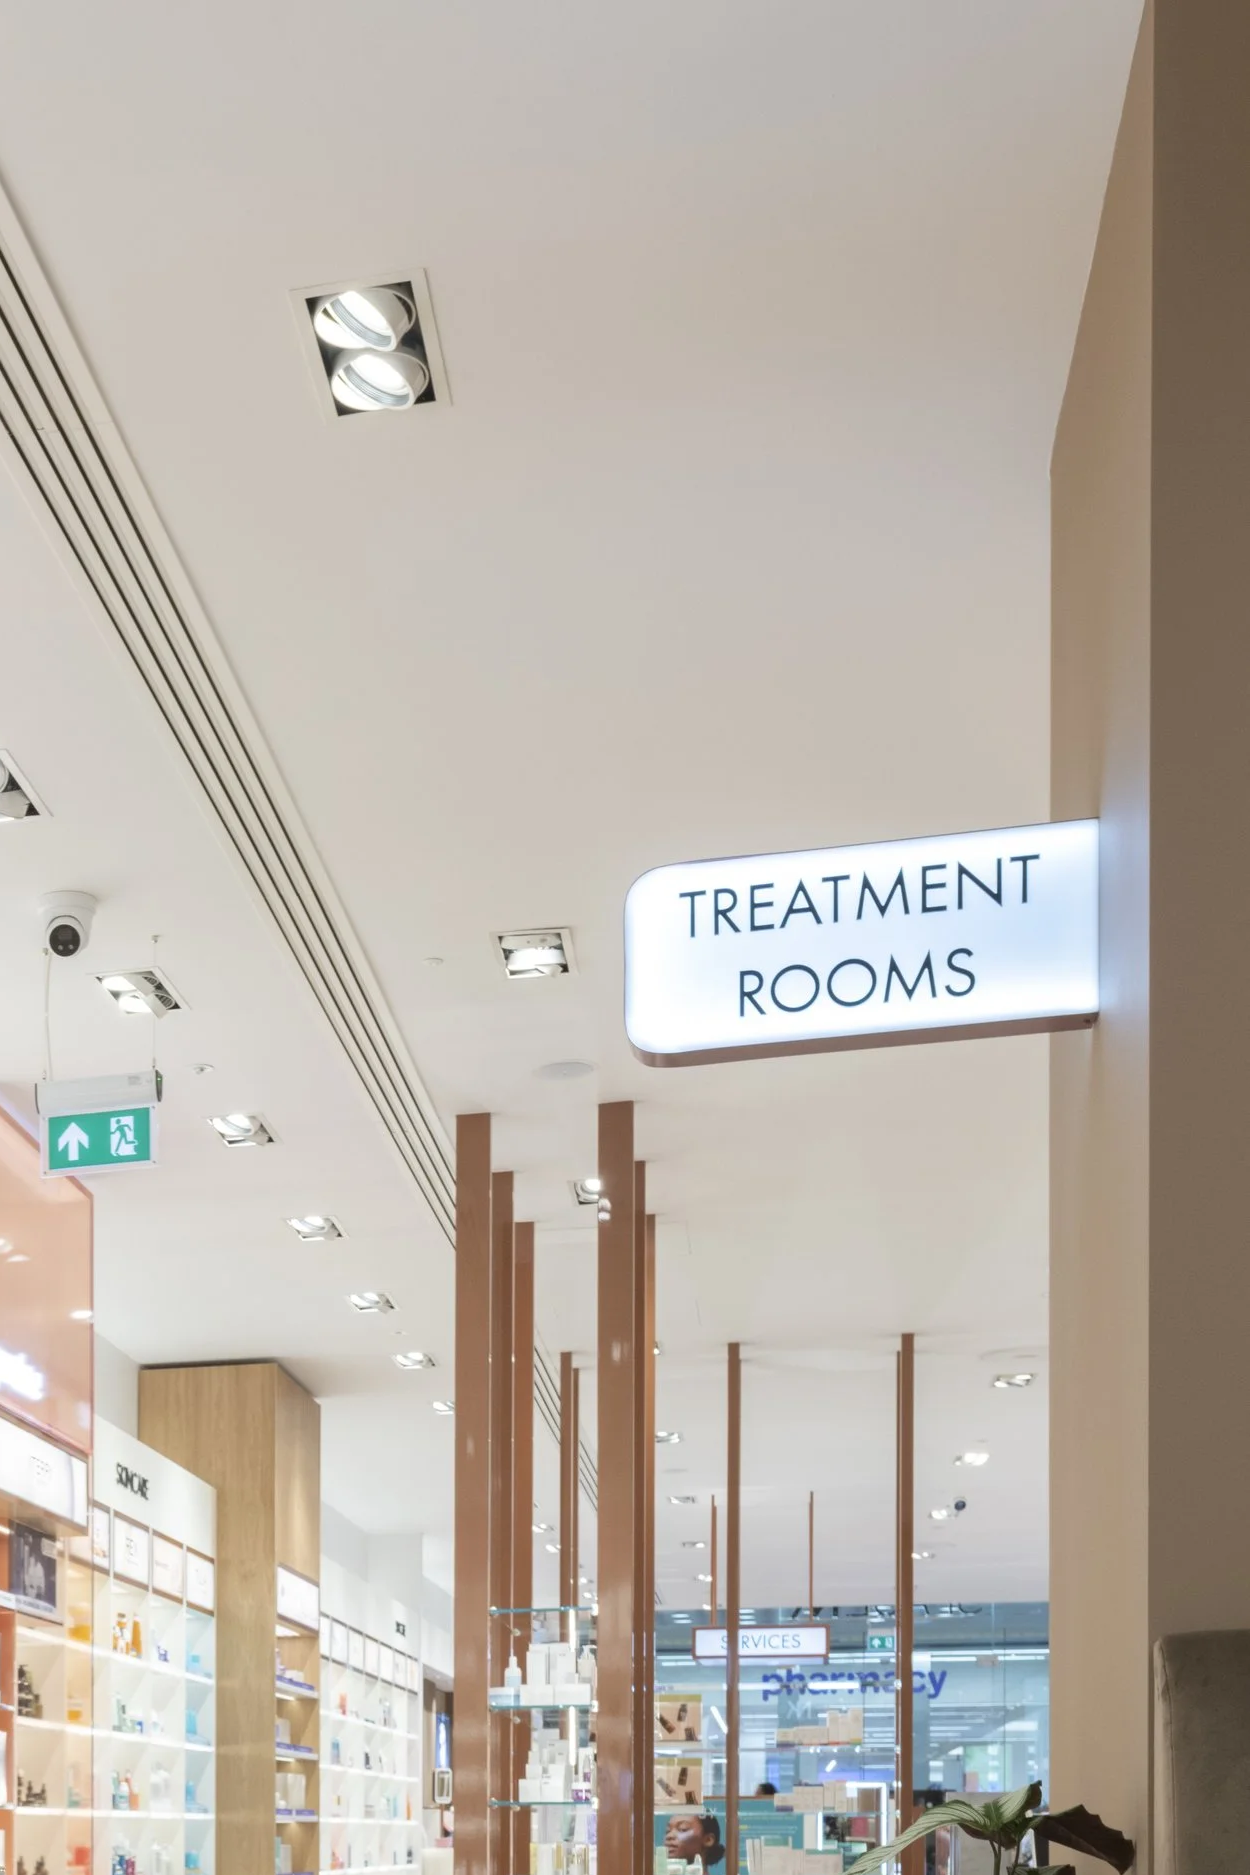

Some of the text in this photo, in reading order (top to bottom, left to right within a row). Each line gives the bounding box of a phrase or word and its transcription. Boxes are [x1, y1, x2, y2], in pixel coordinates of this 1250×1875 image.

[678, 853, 1041, 939] TREATMENT
[738, 947, 976, 1018] ROOMS
[720, 1633, 801, 1650] SRVICES
